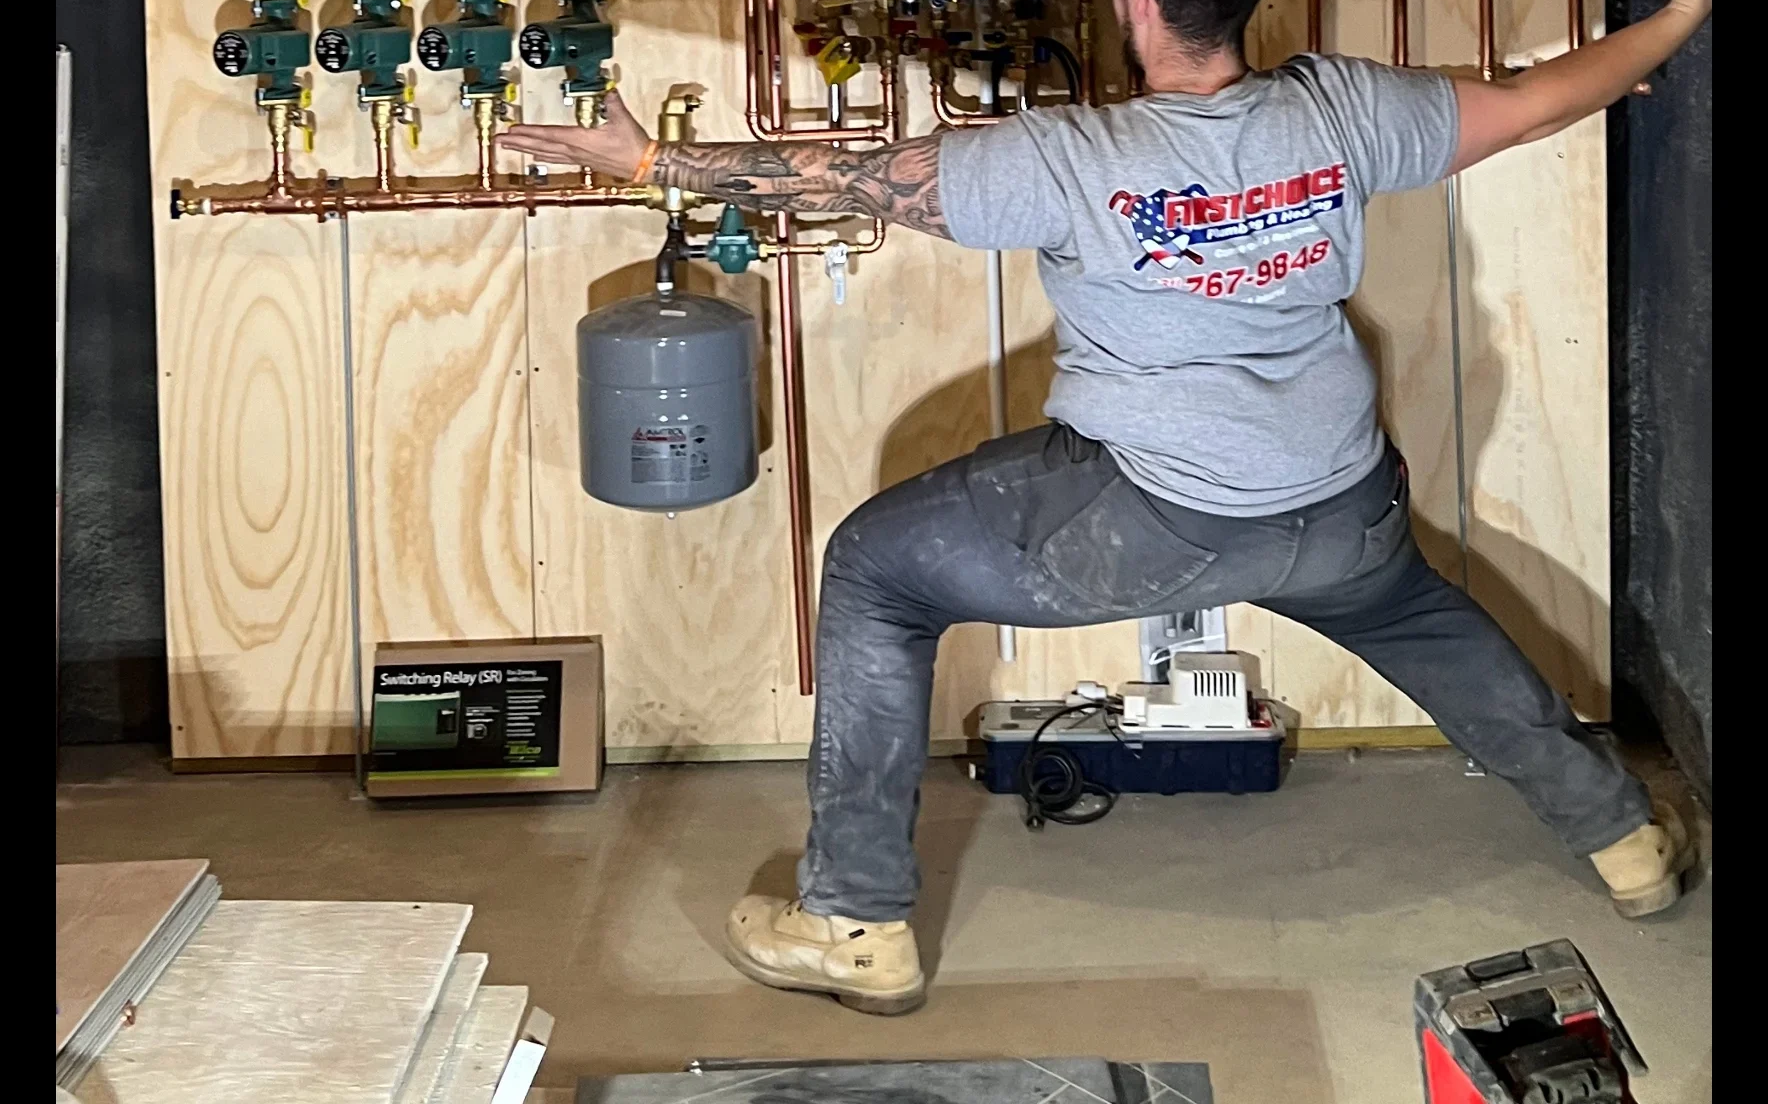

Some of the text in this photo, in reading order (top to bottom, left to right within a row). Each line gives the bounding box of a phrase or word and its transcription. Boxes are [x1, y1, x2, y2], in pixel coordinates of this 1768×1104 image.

[1186, 239, 1330, 297] 767-9848
[380, 669, 502, 688] Switching Relay (SR)
